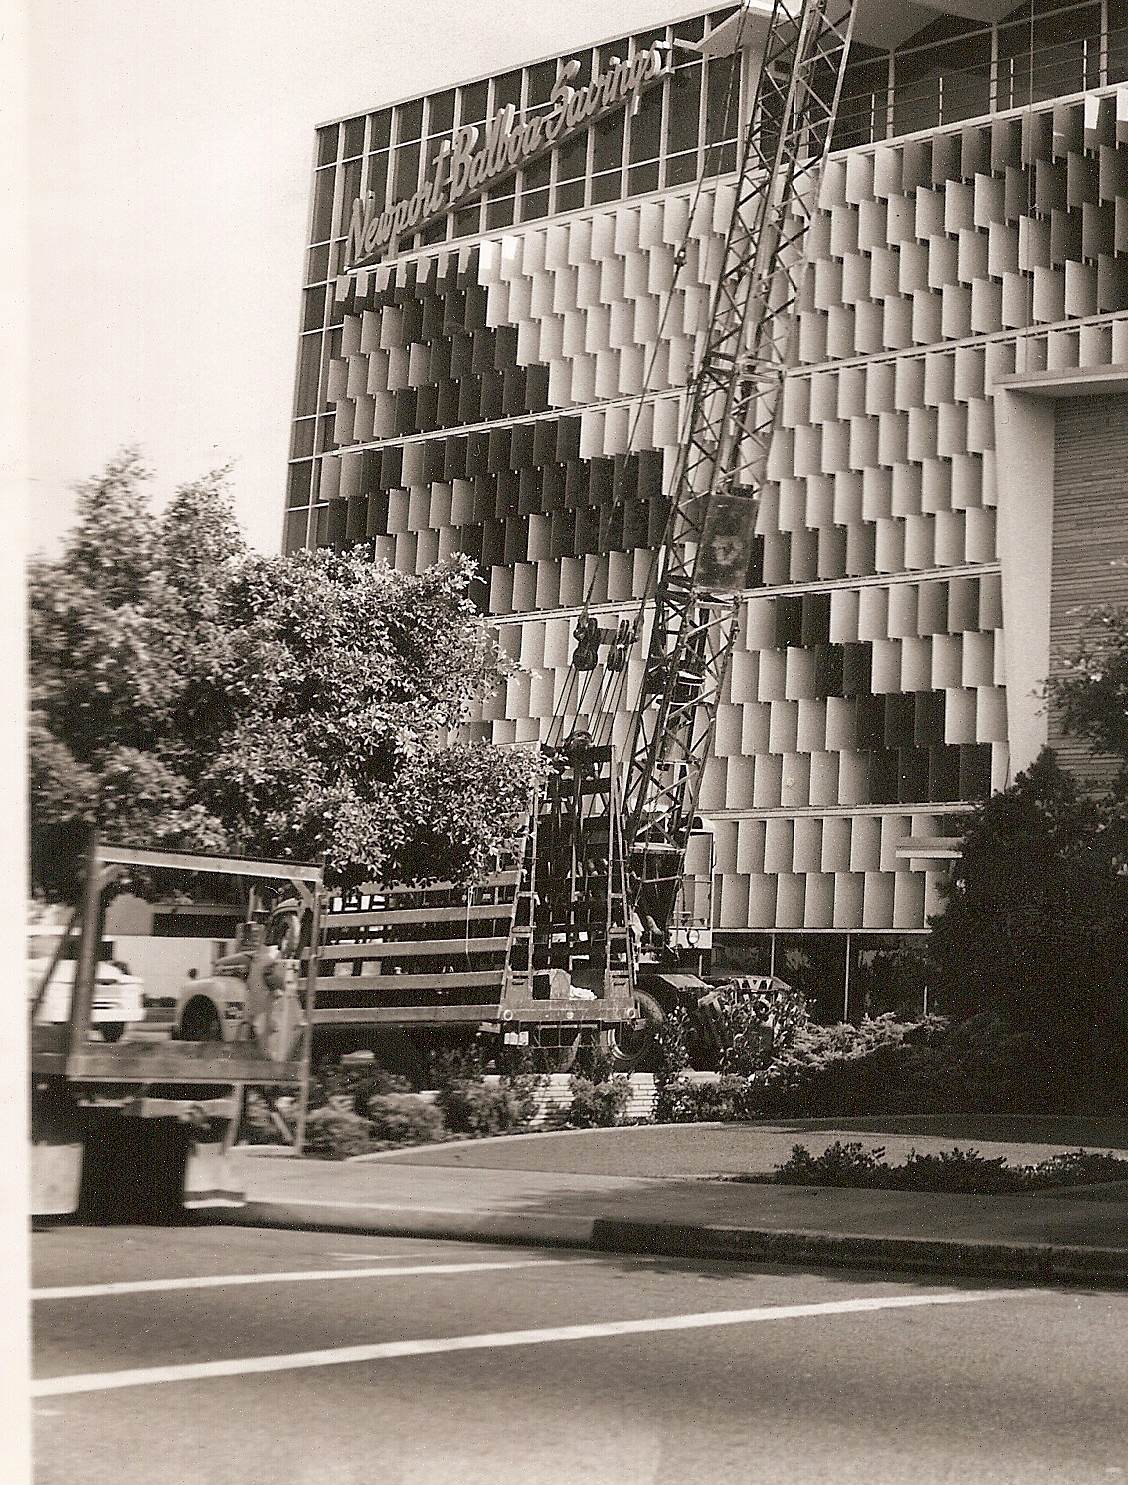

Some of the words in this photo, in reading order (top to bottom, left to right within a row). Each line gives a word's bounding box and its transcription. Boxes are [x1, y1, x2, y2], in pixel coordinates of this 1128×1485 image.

[346, 139, 452, 262] Newport
[449, 103, 544, 198] Balboa
[546, 41, 670, 141] Savings
